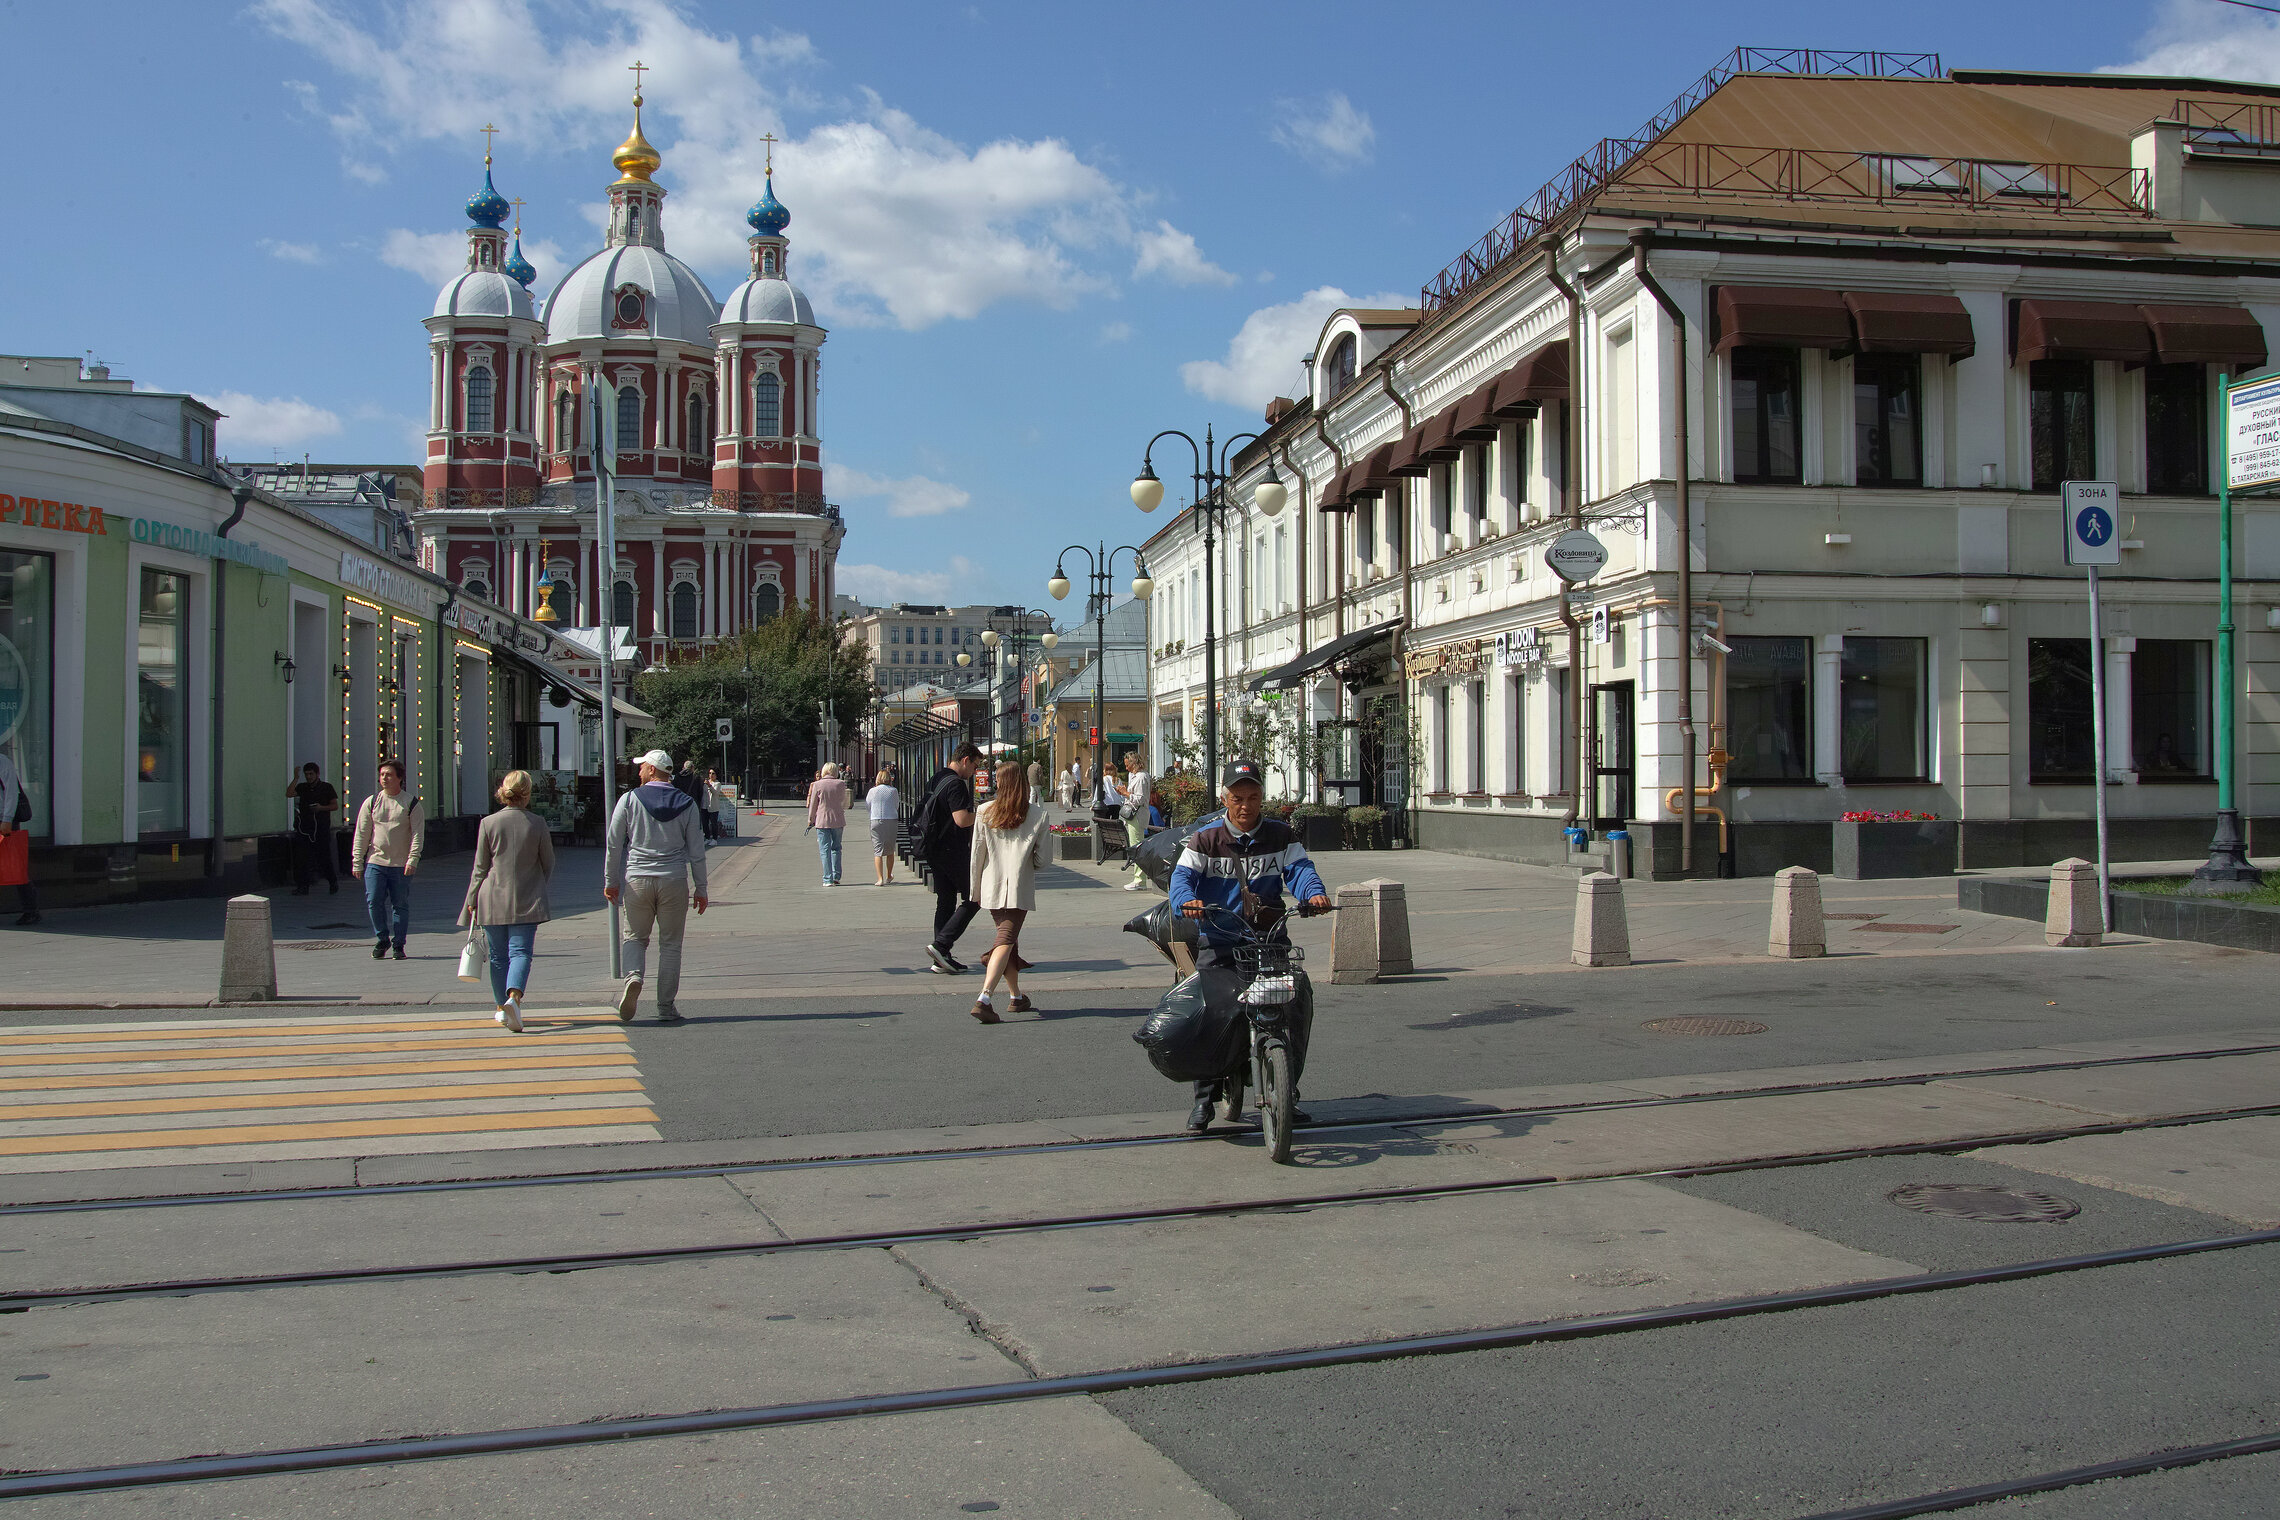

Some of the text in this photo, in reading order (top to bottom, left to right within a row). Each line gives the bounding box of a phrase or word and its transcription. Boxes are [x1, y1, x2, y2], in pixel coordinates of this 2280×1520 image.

[2239, 416, 2276, 436] ДУХОВНЫЙ
[2243, 452, 2259, 464] (495)
[2244, 462, 2259, 473] (999)
[2237, 470, 2269, 483] ТАТАРСКАЯ
[2078, 488, 2107, 498] ЗОНА
[1511, 627, 1534, 649] UDON
[1506, 648, 1540, 666] NOODLE BAR
